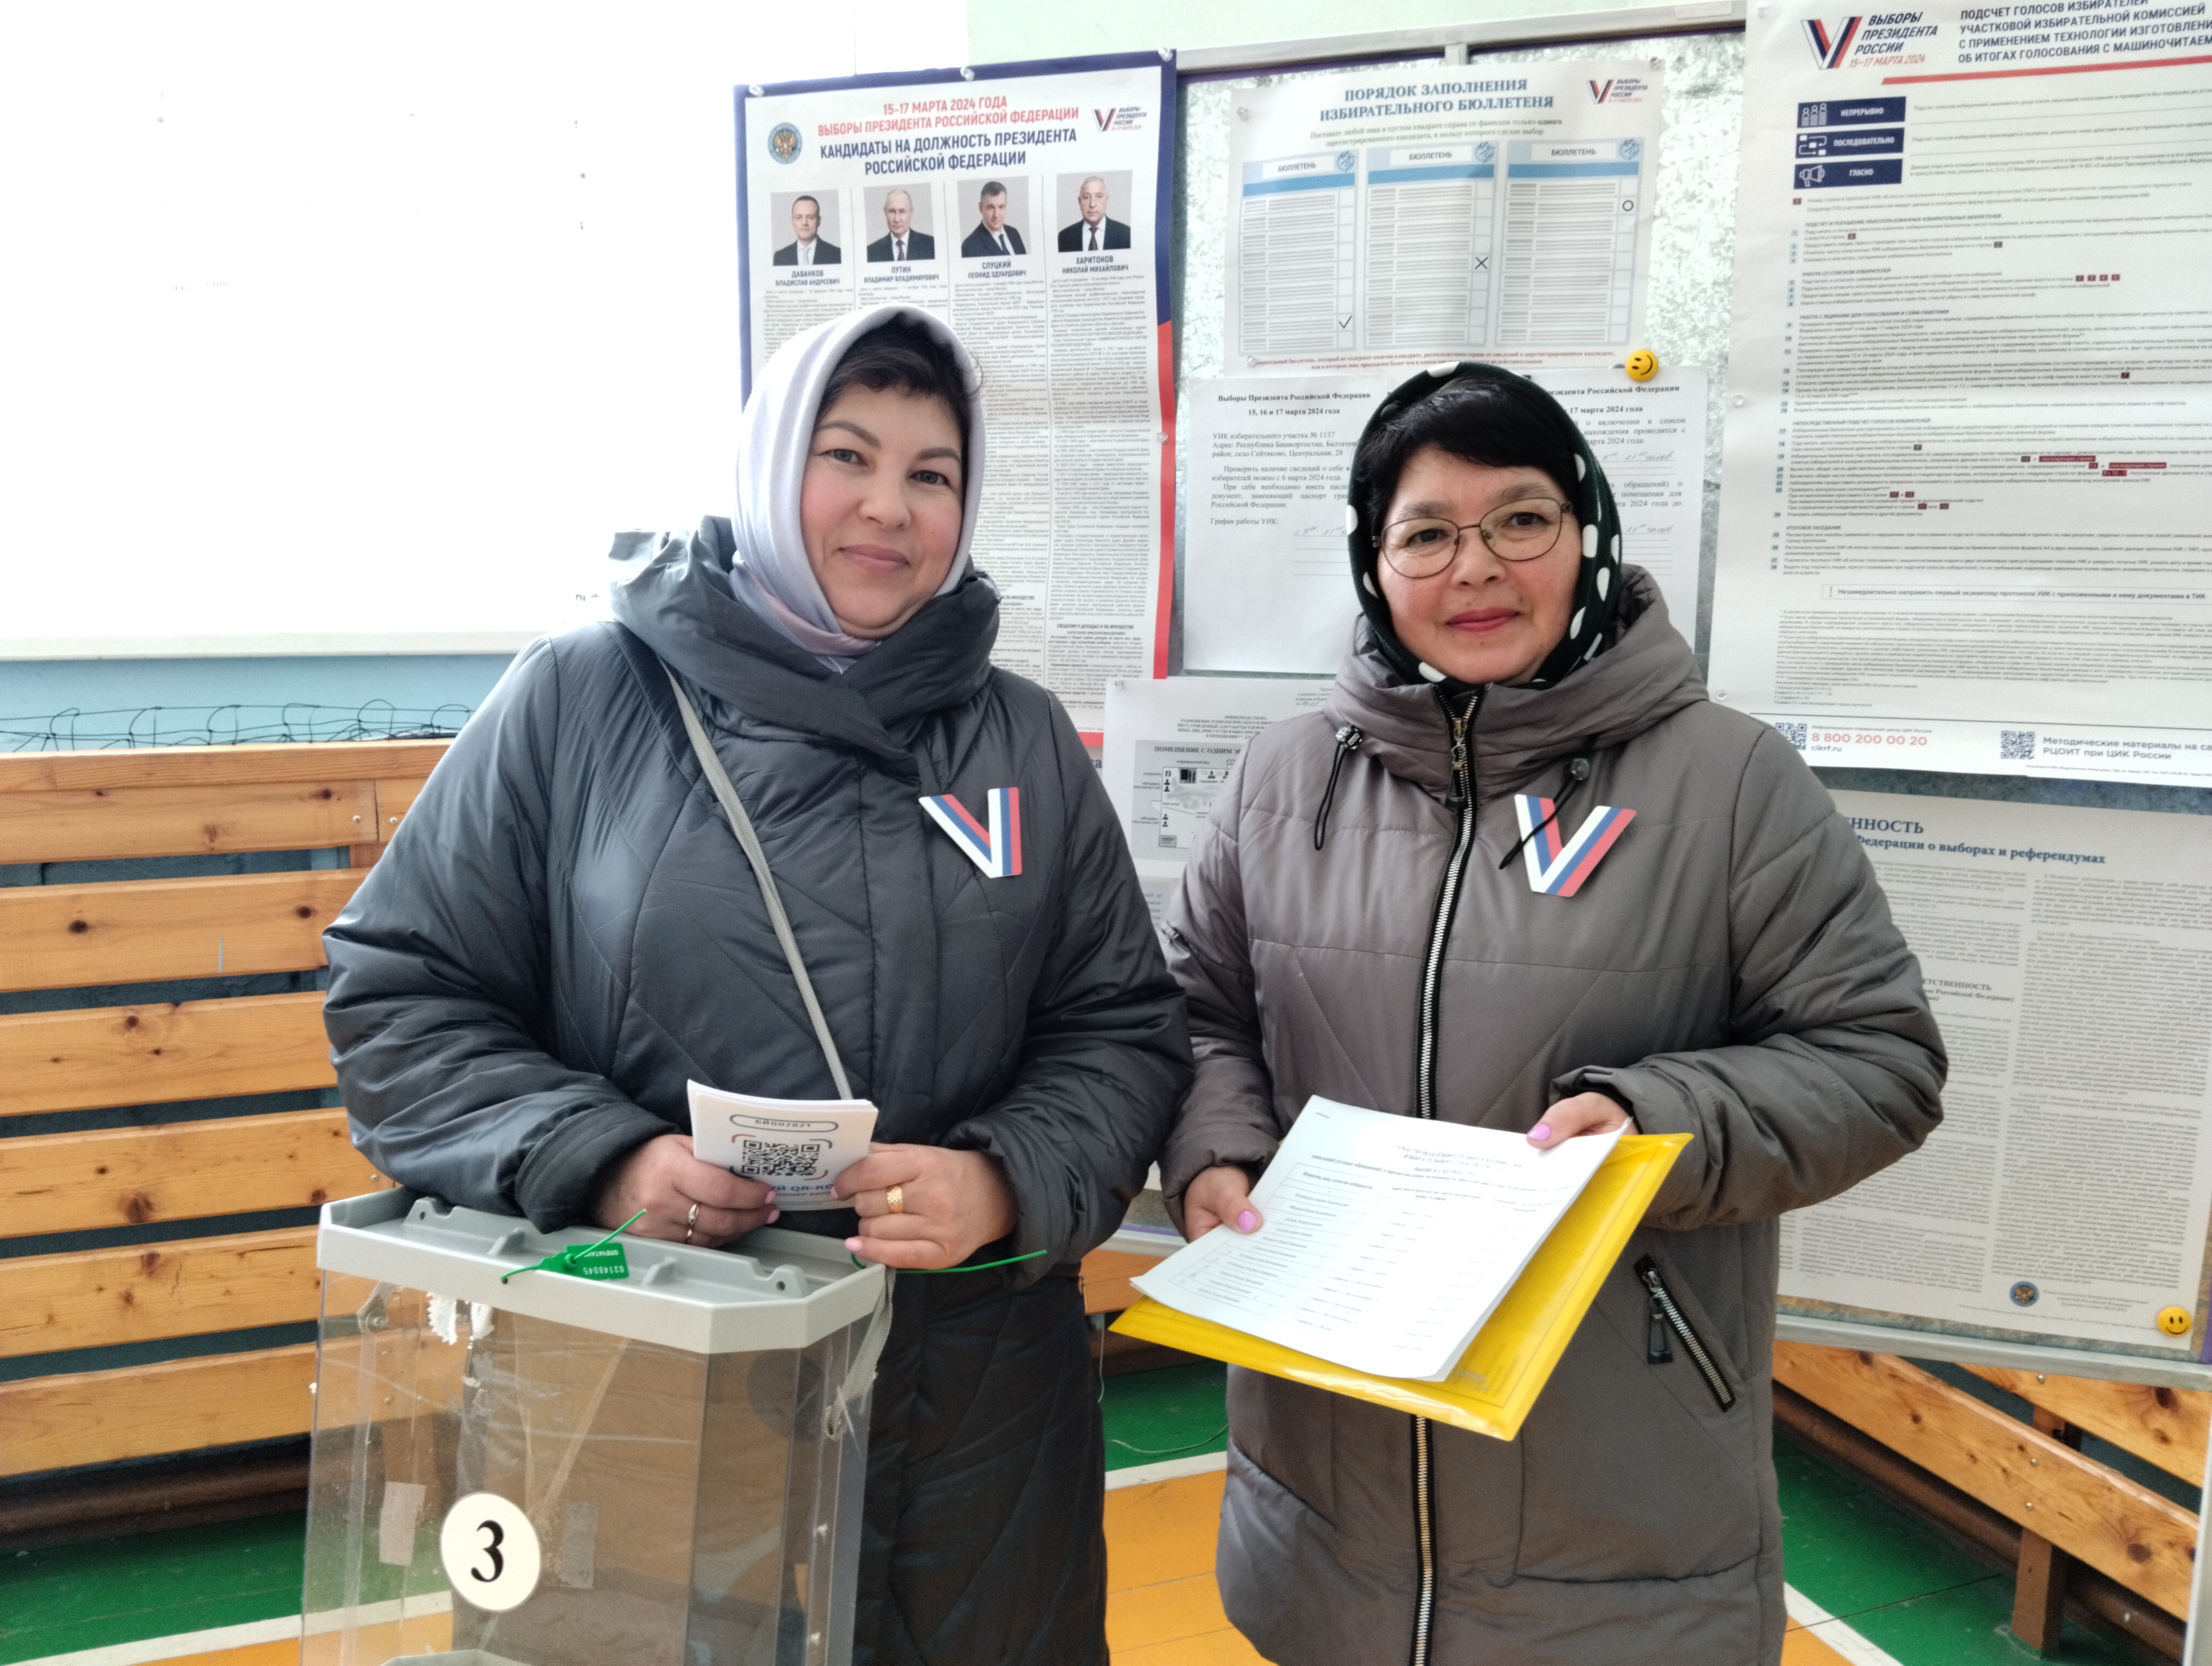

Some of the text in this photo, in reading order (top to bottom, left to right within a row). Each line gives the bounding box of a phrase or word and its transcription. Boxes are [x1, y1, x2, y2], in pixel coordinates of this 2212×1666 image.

[1960, 7, 2011, 20] ПОДСЧЕТ
[2013, 2, 2065, 15] ГОЛОСОВ
[1868, 12, 1924, 26] ВЫБОРЫ
[1960, 3, 2205, 34] УЧАСТКОВОЙ ИЗБИРАТЕЛЬНОЙ КОМИССИЕЙ
[1861, 25, 1938, 41] ПРЕЗИДЕНТА
[1958, 20, 2212, 49] С ПРИМЕНЕНИЕМ ТЕХНОЛОГИИ ИЗГОТОВЛЕНИ
[1854, 42, 1904, 55] РОССИИ
[1958, 35, 2212, 63] ОБ ИТОГАХ ГОЛОСОВАНИЯ С МАШИНОЧИТАЕМ
[1874, 56, 1903, 66] МАРТА
[1904, 54, 1926, 64] 2024
[1345, 79, 1527, 101] ПОРЯДОК ЗАПОЛНЕНИЯ
[911, 99, 948, 113] МАРТА
[949, 98, 976, 113] 2024
[978, 95, 1007, 111] ГОДА
[1320, 96, 1553, 120] ИЗБИРАТЕЛЬНОГО БЮЛЛЕТЕНЯ
[1841, 107, 1884, 117] НЕПРЕРЫВНО
[818, 107, 1079, 136] ВЫБОРЫ ПРЕЗИДЕНТА РОССИЙСКОЙ ФЕДЕРАЦИИ
[820, 128, 1077, 158] КАНДИДАТЫ НА ДОЛЖНОСТЬ ПРЕЗИДЕНТА
[1834, 136, 1894, 146] ПОСЛЕДОВАТЕЛЬНО
[1409, 151, 1452, 161] БЮЛЛЕТЕНЬ
[1551, 147, 1596, 157] БЮЛЛЕТЕНЬ
[864, 151, 1026, 175] РОССИЙСКОЙ ФЕДЕРАЦИИ
[1278, 161, 1316, 172] БЮЛЛЕТЕНЬ
[1849, 168, 1873, 177] ГЛАСНО
[1076, 255, 1114, 265] ХАРИТОНОВ
[891, 266, 911, 274] ПУТИН
[982, 261, 1011, 270] СЛУЦКИЙ
[1062, 264, 1129, 274] НИКОЛАЙ МИХАЙЛОВИЧ
[792, 270, 824, 278] ДАВАНКОВ
[895, 274, 940, 282] ВЛАДИМИРОВИЧ
[991, 270, 1026, 278] ЭДУАРДОВИЧ
[1248, 394, 1288, 402] Президента
[1230, 432, 1282, 440] избирательного
[1236, 441, 1274, 449] Республика
[1211, 450, 1233, 458] район,
[1223, 465, 1259, 473] Проверить
[1211, 474, 1251, 482] избирателей
[1223, 483, 1237, 491] При
[1249, 501, 1288, 509] Федерации.
[1210, 517, 1234, 526] График
[1235, 517, 1259, 526] работы
[1811, 732, 1927, 746] 8 800 200 00 20
[2042, 737, 2120, 747] Методические
[2122, 741, 2182, 749] материалы
[2042, 747, 2081, 755] РЦОИТ
[2106, 749, 2130, 758] ЦИК
[2132, 750, 2171, 759] России
[1938, 842, 1995, 856] выборах
[1998, 848, 2007, 856] и
[2009, 848, 2105, 863] референдумах
[790, 1184, 834, 1192] QR-КО
[583, 1265, 625, 1275] 03148045
[471, 1520, 504, 1582] 3
